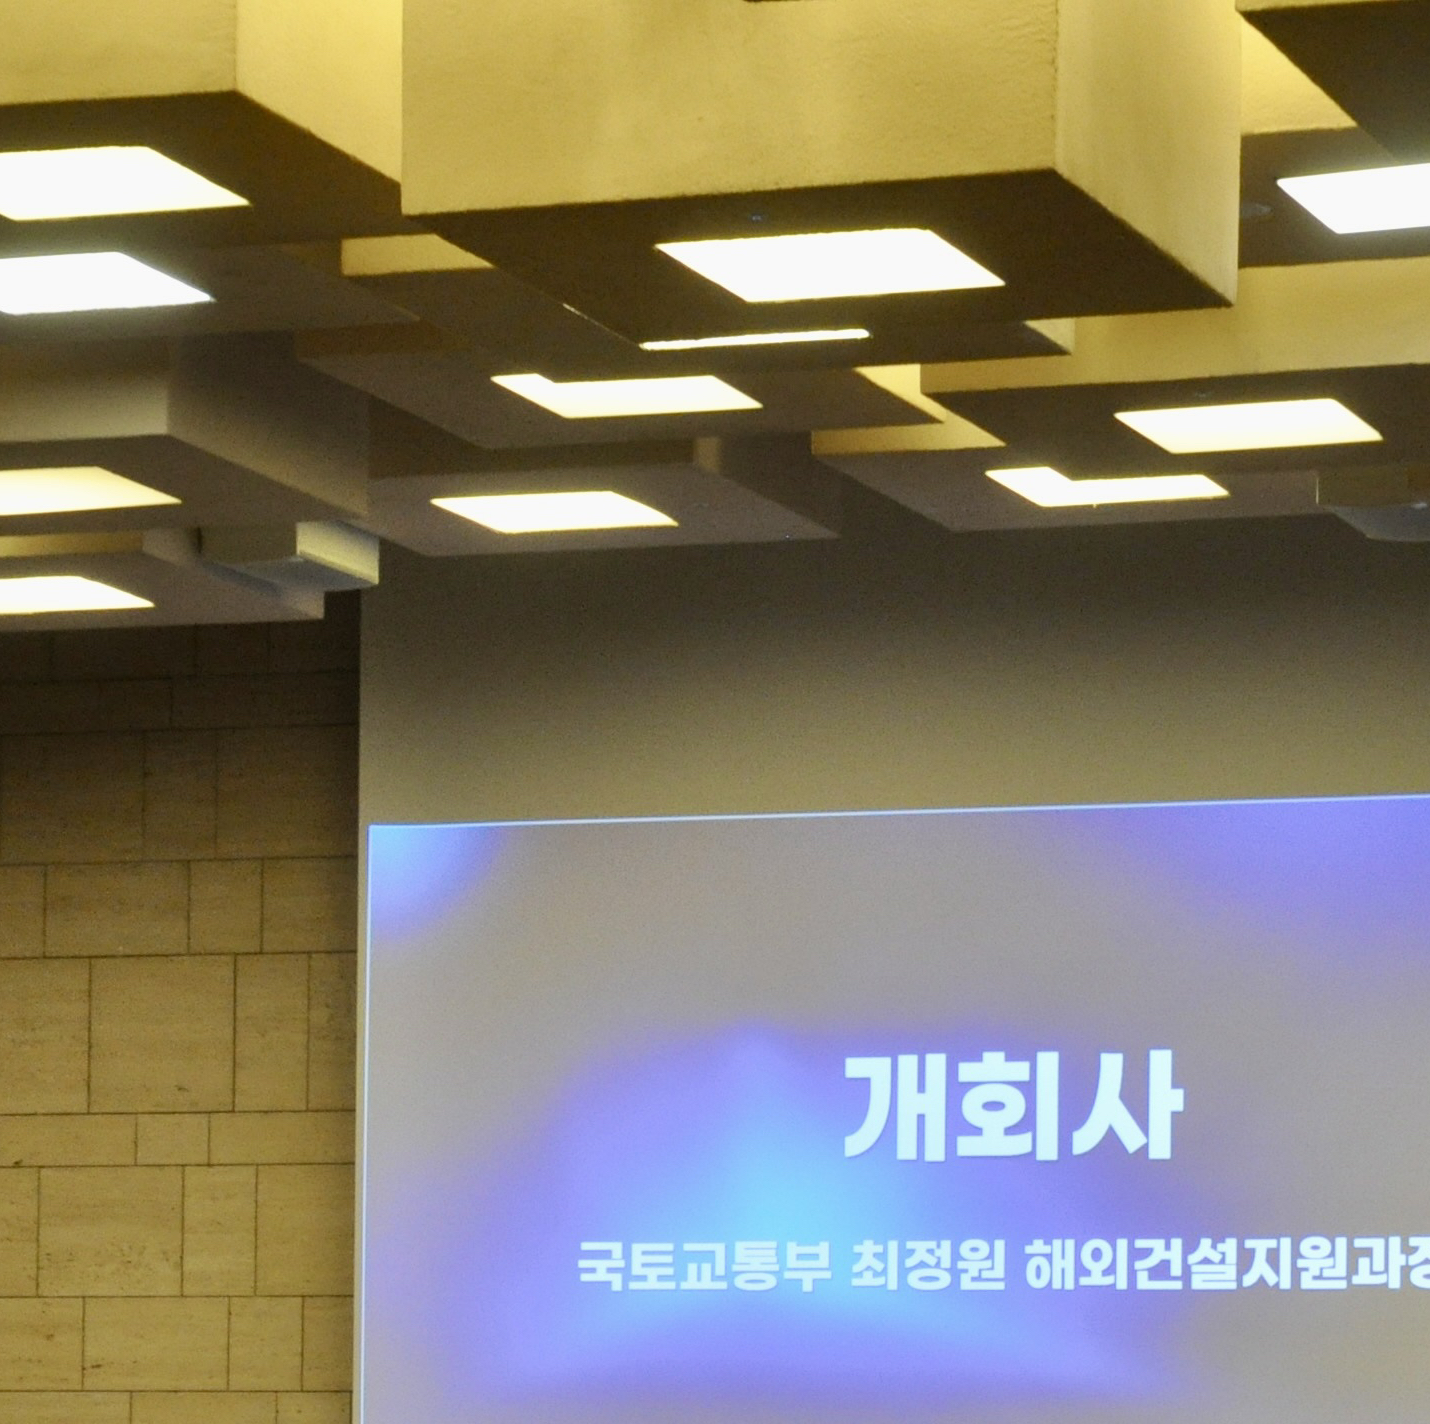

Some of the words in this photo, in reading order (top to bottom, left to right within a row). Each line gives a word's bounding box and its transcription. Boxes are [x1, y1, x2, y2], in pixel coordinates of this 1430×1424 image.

[843, 1049, 1183, 1162] 개회사
[576, 1239, 833, 1292] 국토교통부
[851, 1238, 1007, 1292] 최정원
